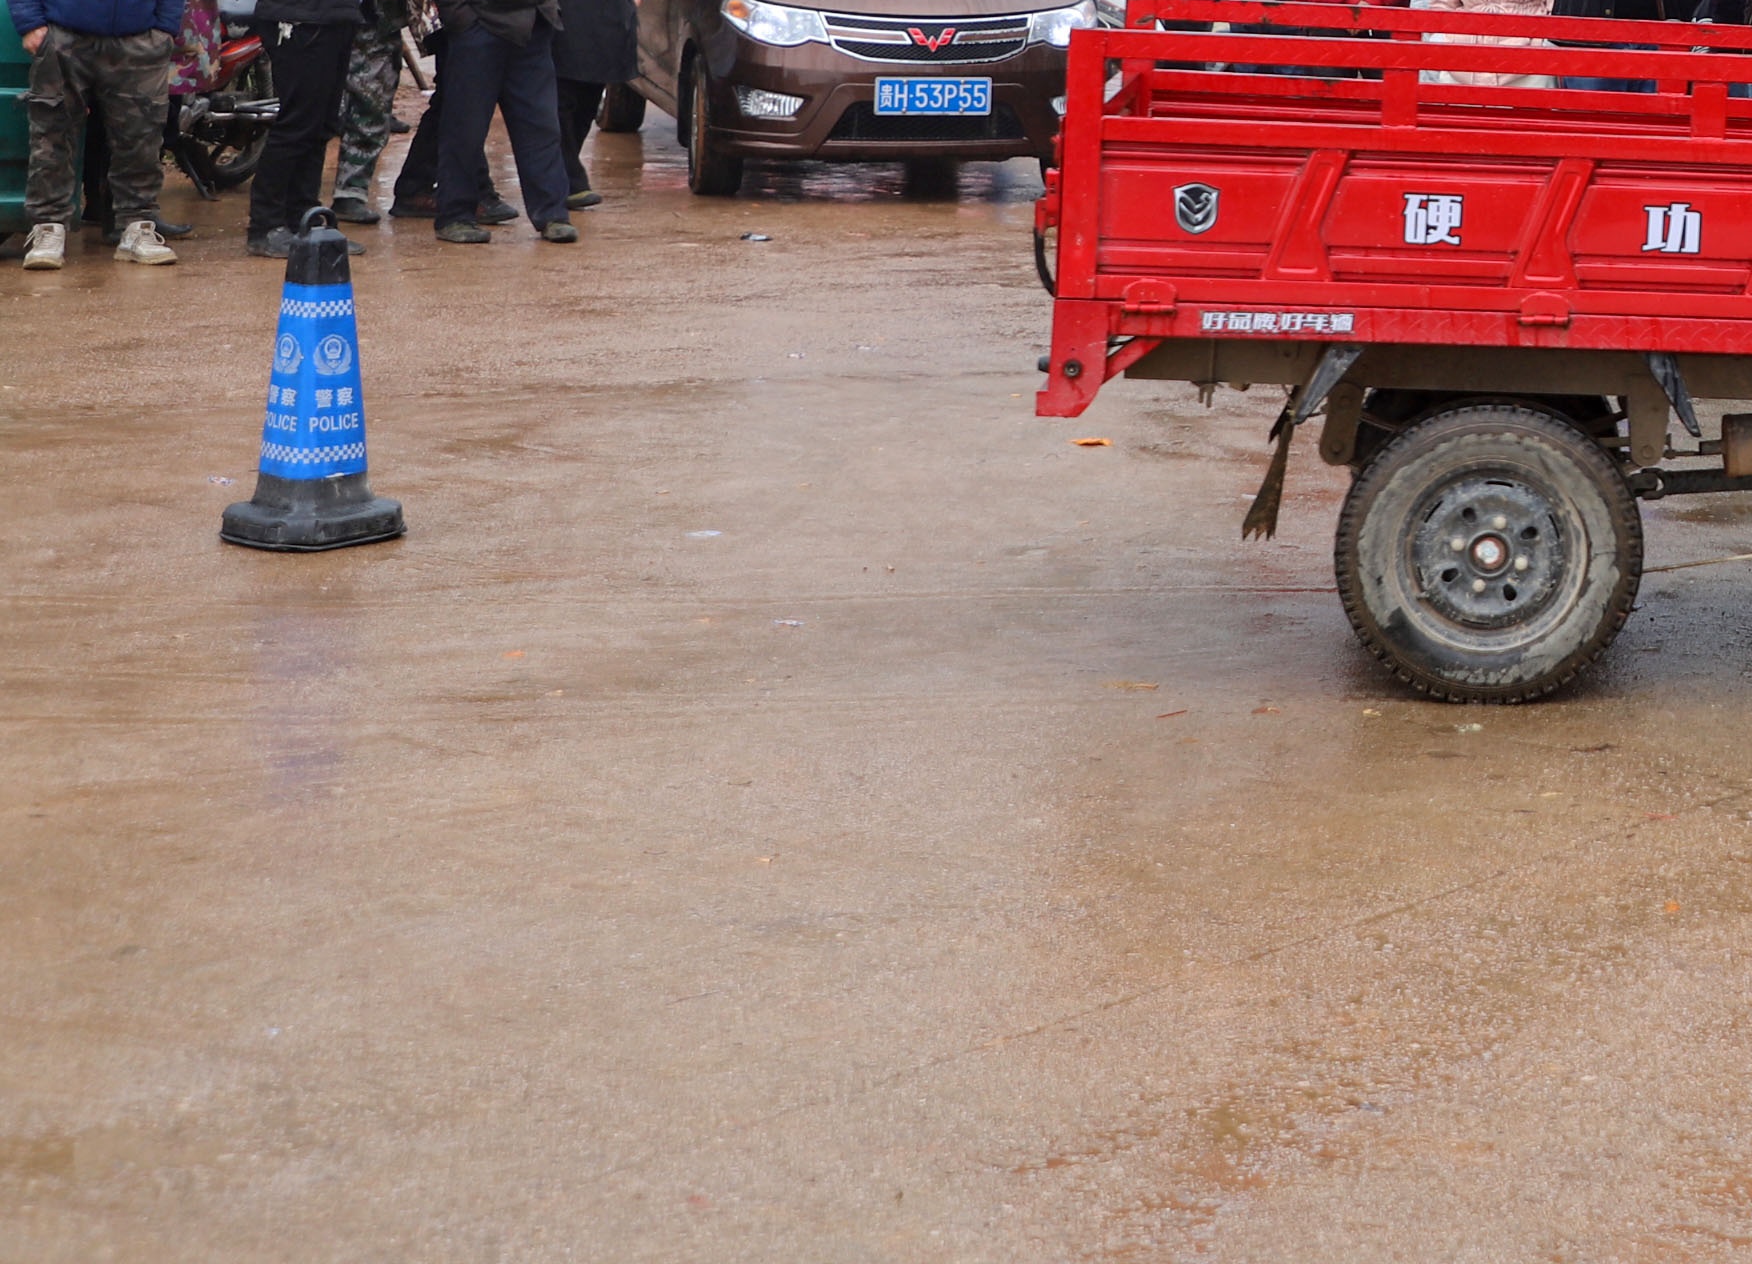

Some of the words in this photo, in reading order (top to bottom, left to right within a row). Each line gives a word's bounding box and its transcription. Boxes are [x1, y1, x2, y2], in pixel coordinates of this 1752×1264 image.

[315, 387, 354, 408] 警察
[266, 411, 298, 432] OLICE
[309, 412, 359, 433] POLICE
